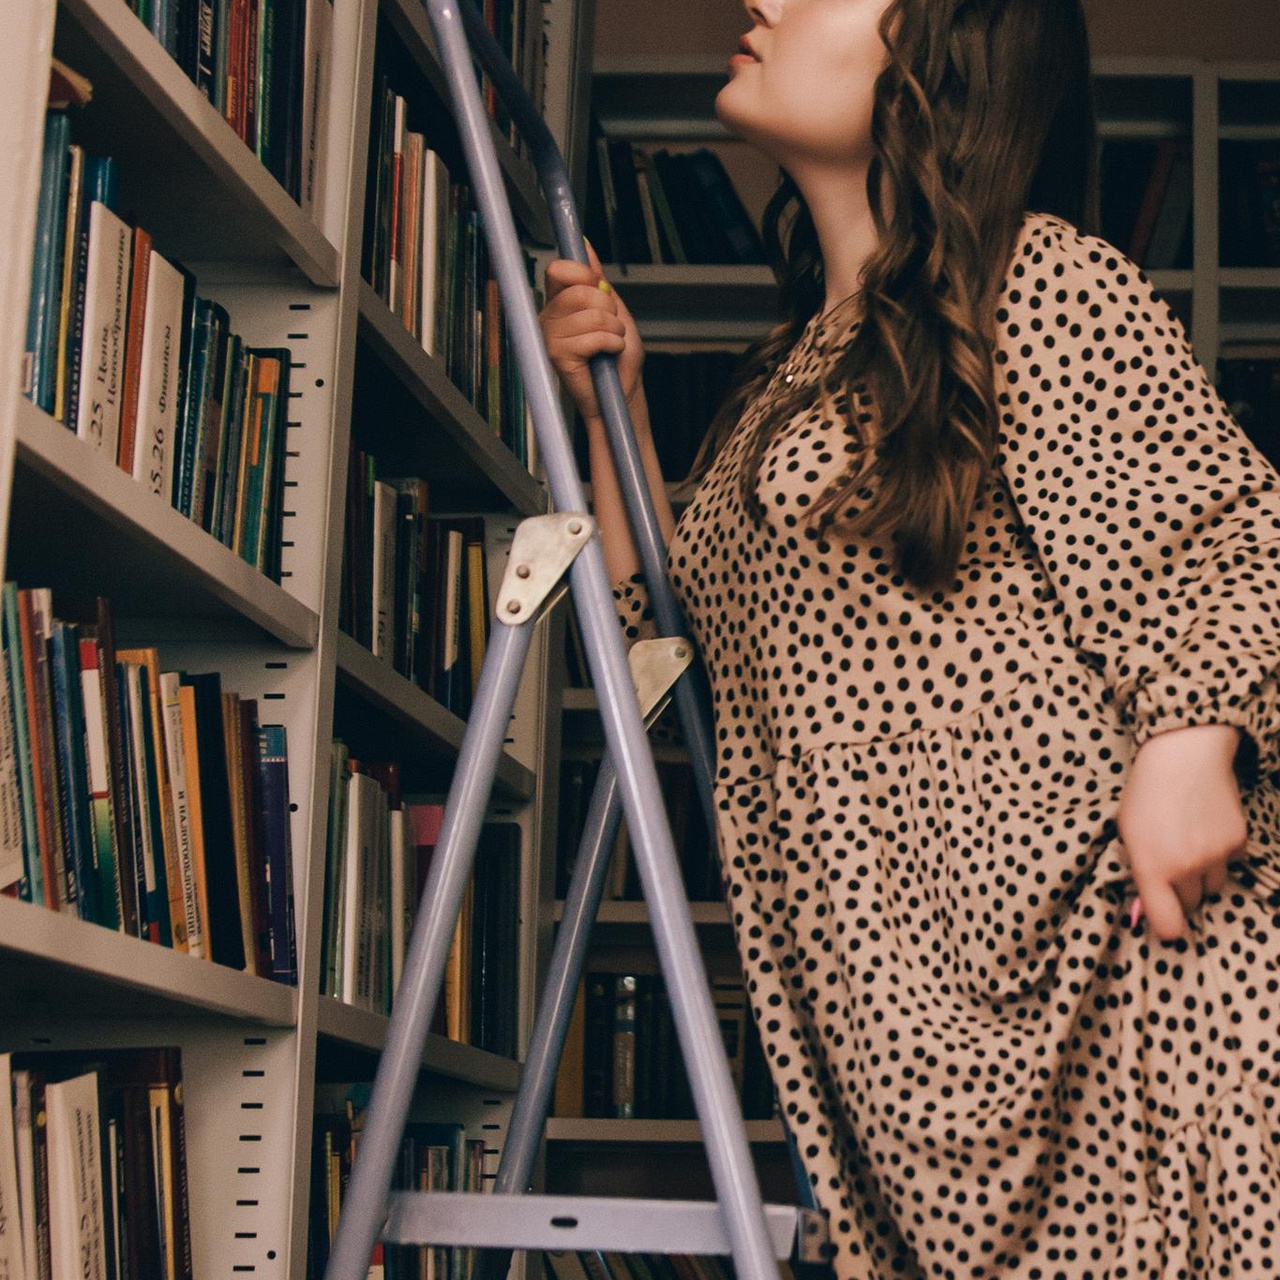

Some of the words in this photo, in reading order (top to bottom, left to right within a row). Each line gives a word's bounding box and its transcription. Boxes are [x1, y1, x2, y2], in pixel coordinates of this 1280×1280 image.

[106, 228, 125, 406] Ценообразование
[158, 326, 171, 413] Финансы
[89, 401, 104, 446] .25
[178, 804, 197, 938] НАЛОГООБЛОЖЕНИЕ
